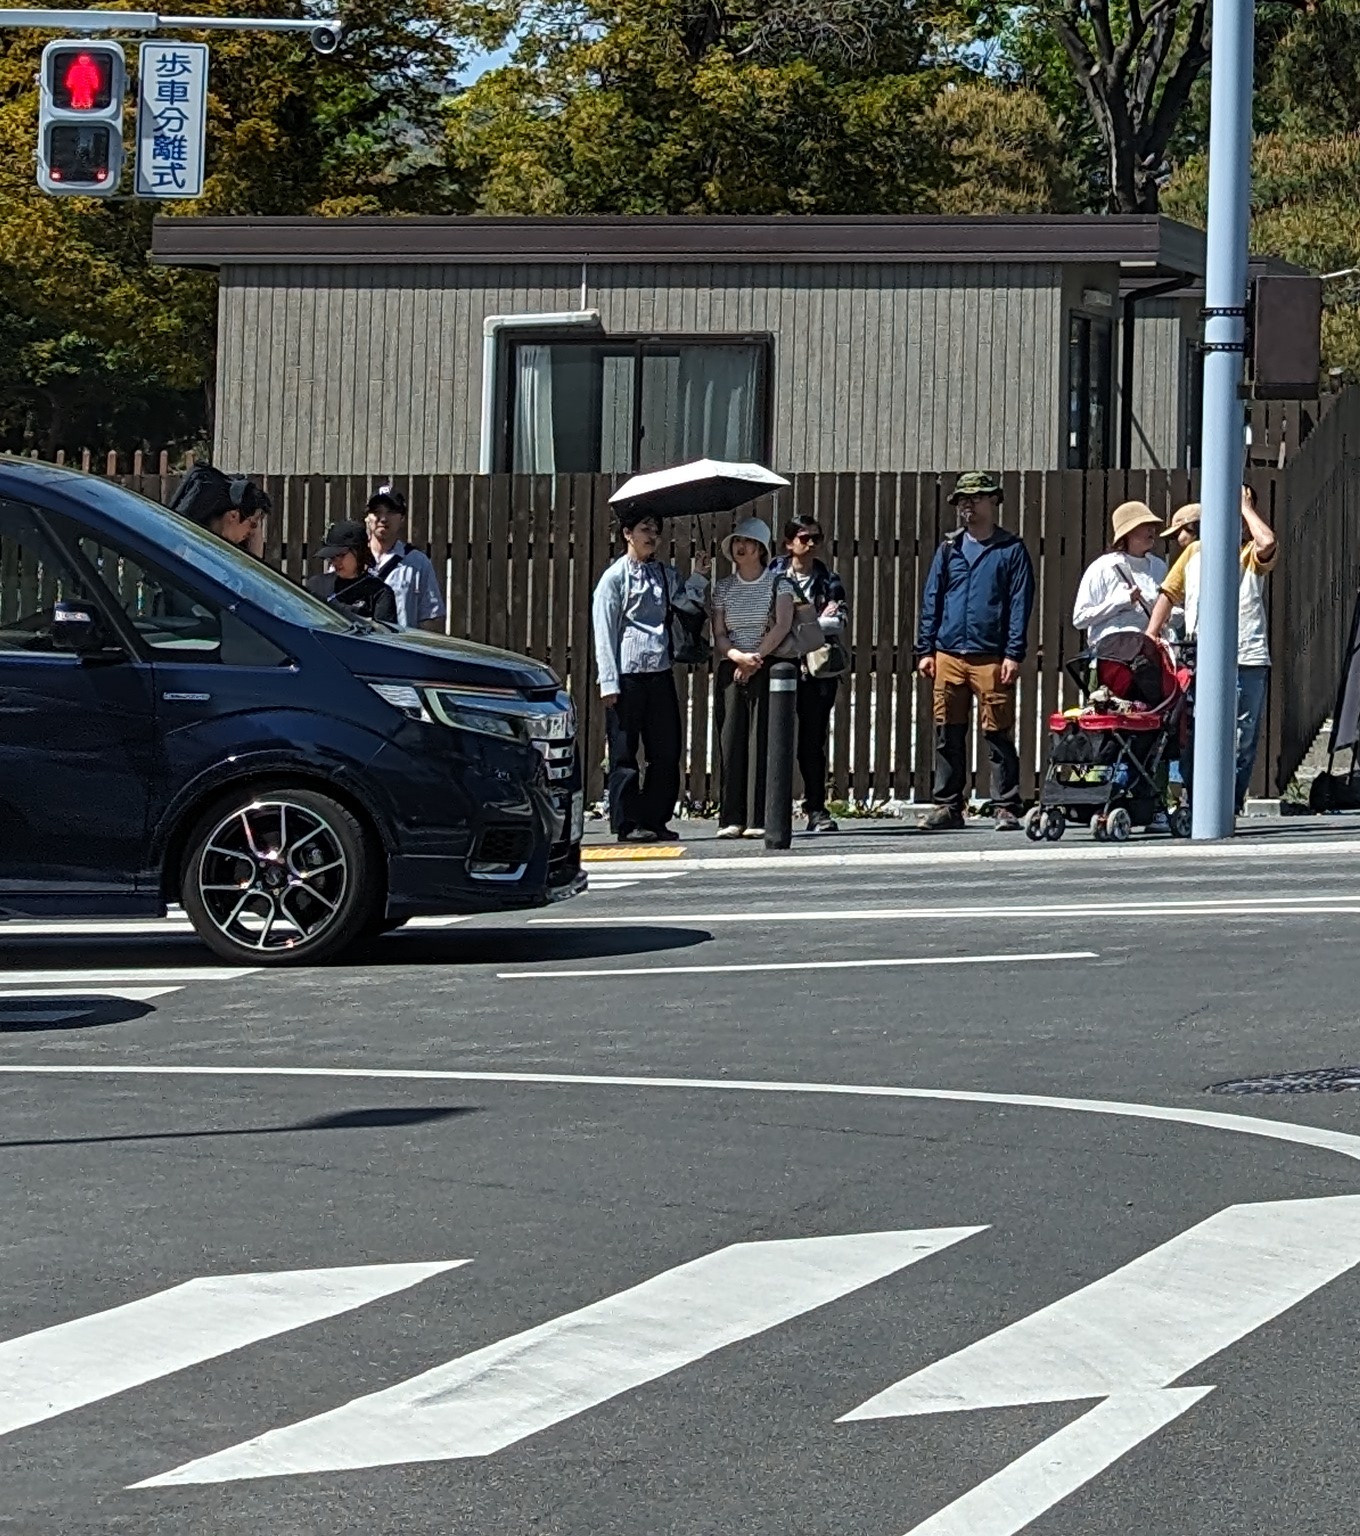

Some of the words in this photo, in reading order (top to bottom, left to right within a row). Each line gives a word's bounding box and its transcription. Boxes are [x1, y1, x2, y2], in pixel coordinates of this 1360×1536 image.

[151, 51, 192, 190] 歩車分離式
